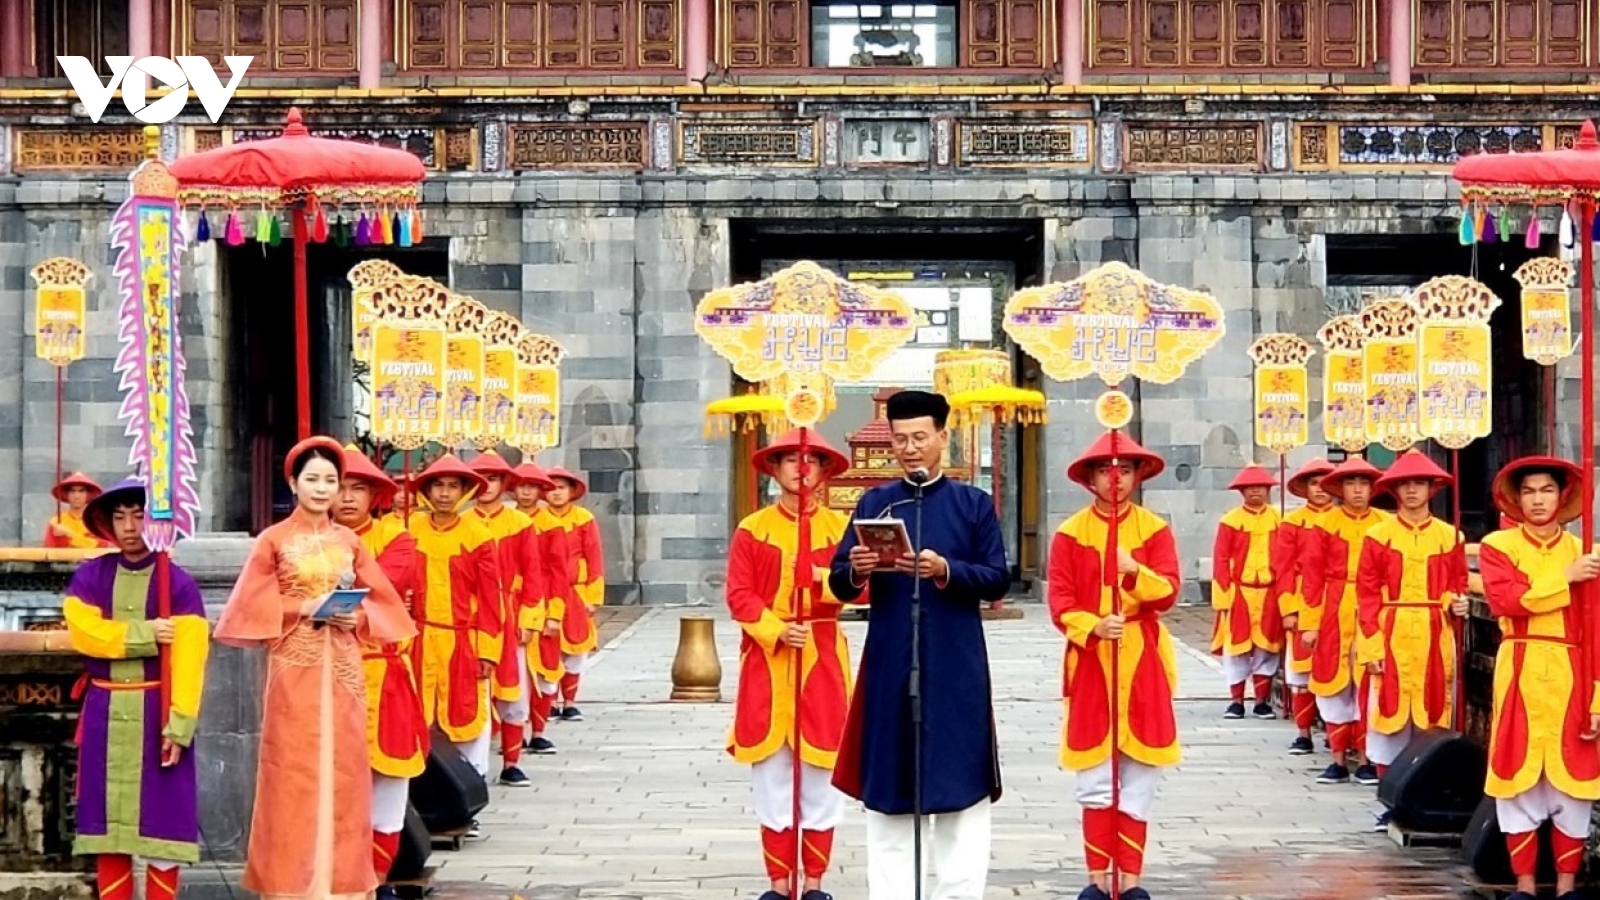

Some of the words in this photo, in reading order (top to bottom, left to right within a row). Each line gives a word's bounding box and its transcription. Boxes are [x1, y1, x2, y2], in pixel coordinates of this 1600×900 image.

[763, 315, 831, 328] FESTIVAL
[1072, 315, 1136, 328] FESTIVAL
[381, 363, 436, 376] FESTIVAL
[1429, 362, 1481, 376] FESTIVAL
[445, 370, 475, 382] TIVAL
[384, 420, 430, 433] 2024
